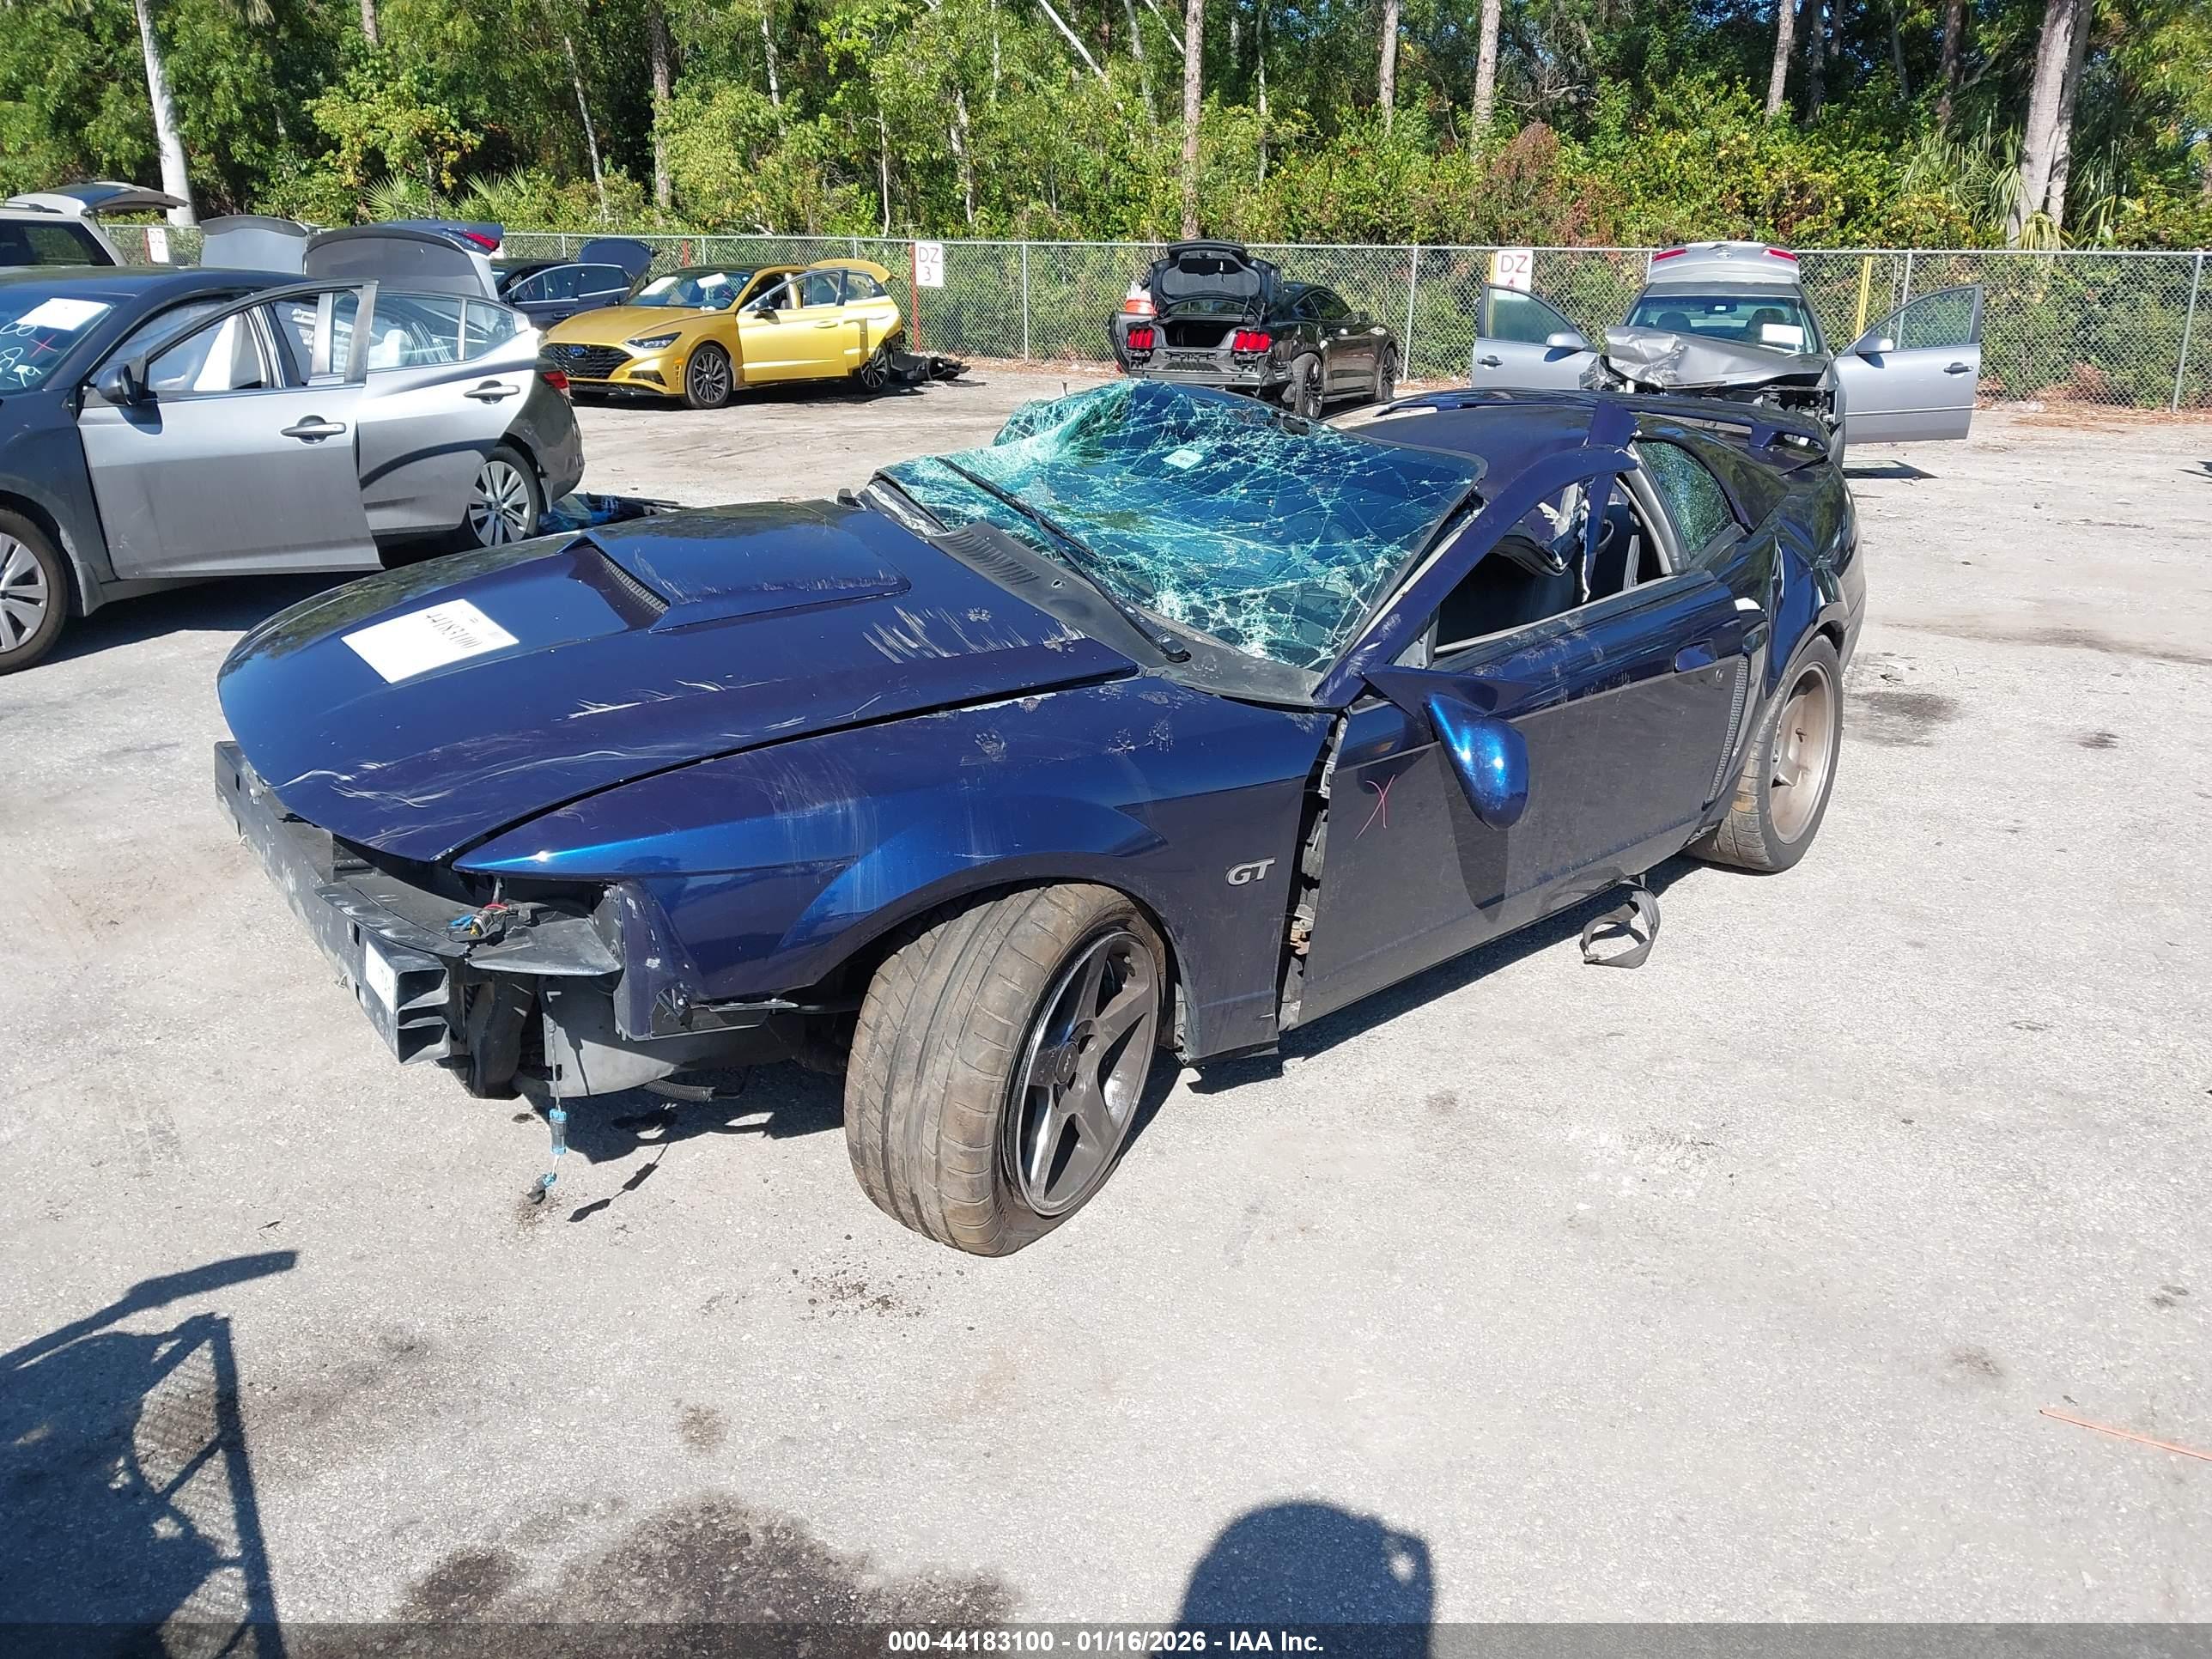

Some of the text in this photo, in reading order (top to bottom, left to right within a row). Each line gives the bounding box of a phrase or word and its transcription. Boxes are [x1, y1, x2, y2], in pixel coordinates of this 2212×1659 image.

[149, 230, 164, 244] DZ
[919, 246, 940, 264] DZ
[1500, 254, 1528, 273] DZ
[924, 265, 932, 282] 3
[1225, 857, 1276, 885] GT
